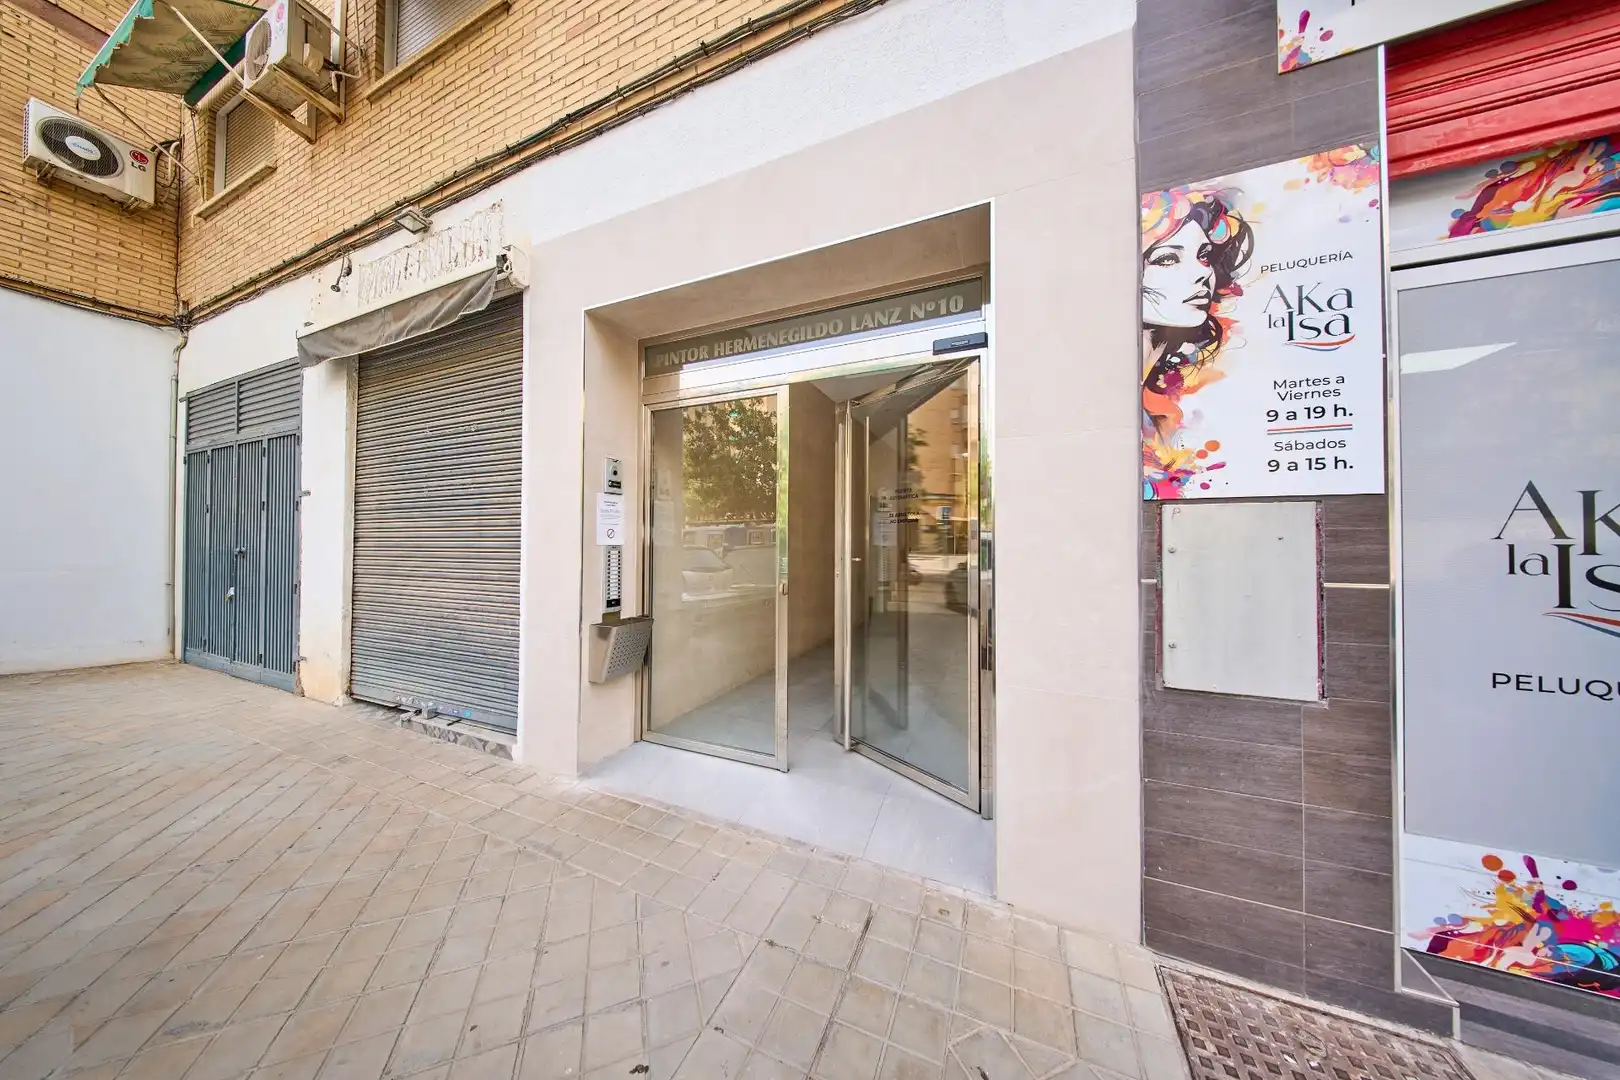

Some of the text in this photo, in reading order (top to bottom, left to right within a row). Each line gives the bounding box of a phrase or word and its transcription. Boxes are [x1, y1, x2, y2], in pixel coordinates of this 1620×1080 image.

[131, 161, 147, 172] LG
[1260, 250, 1353, 274] PELUQUERÍA
[1268, 314, 1286, 329] la
[655, 345, 709, 367] PINTOR
[714, 318, 843, 358] HERMENEGILDO
[851, 306, 902, 332] LANZ
[1273, 375, 1345, 390] Martes a
[1277, 388, 1341, 401] Viernes
[1266, 404, 1353, 422] 9 a 19 h.
[1274, 438, 1346, 451] Sábados
[1267, 456, 1353, 472] 9 a 15 h.
[1506, 544, 1551, 576] la
[1492, 672, 1620, 702] PELUQ
